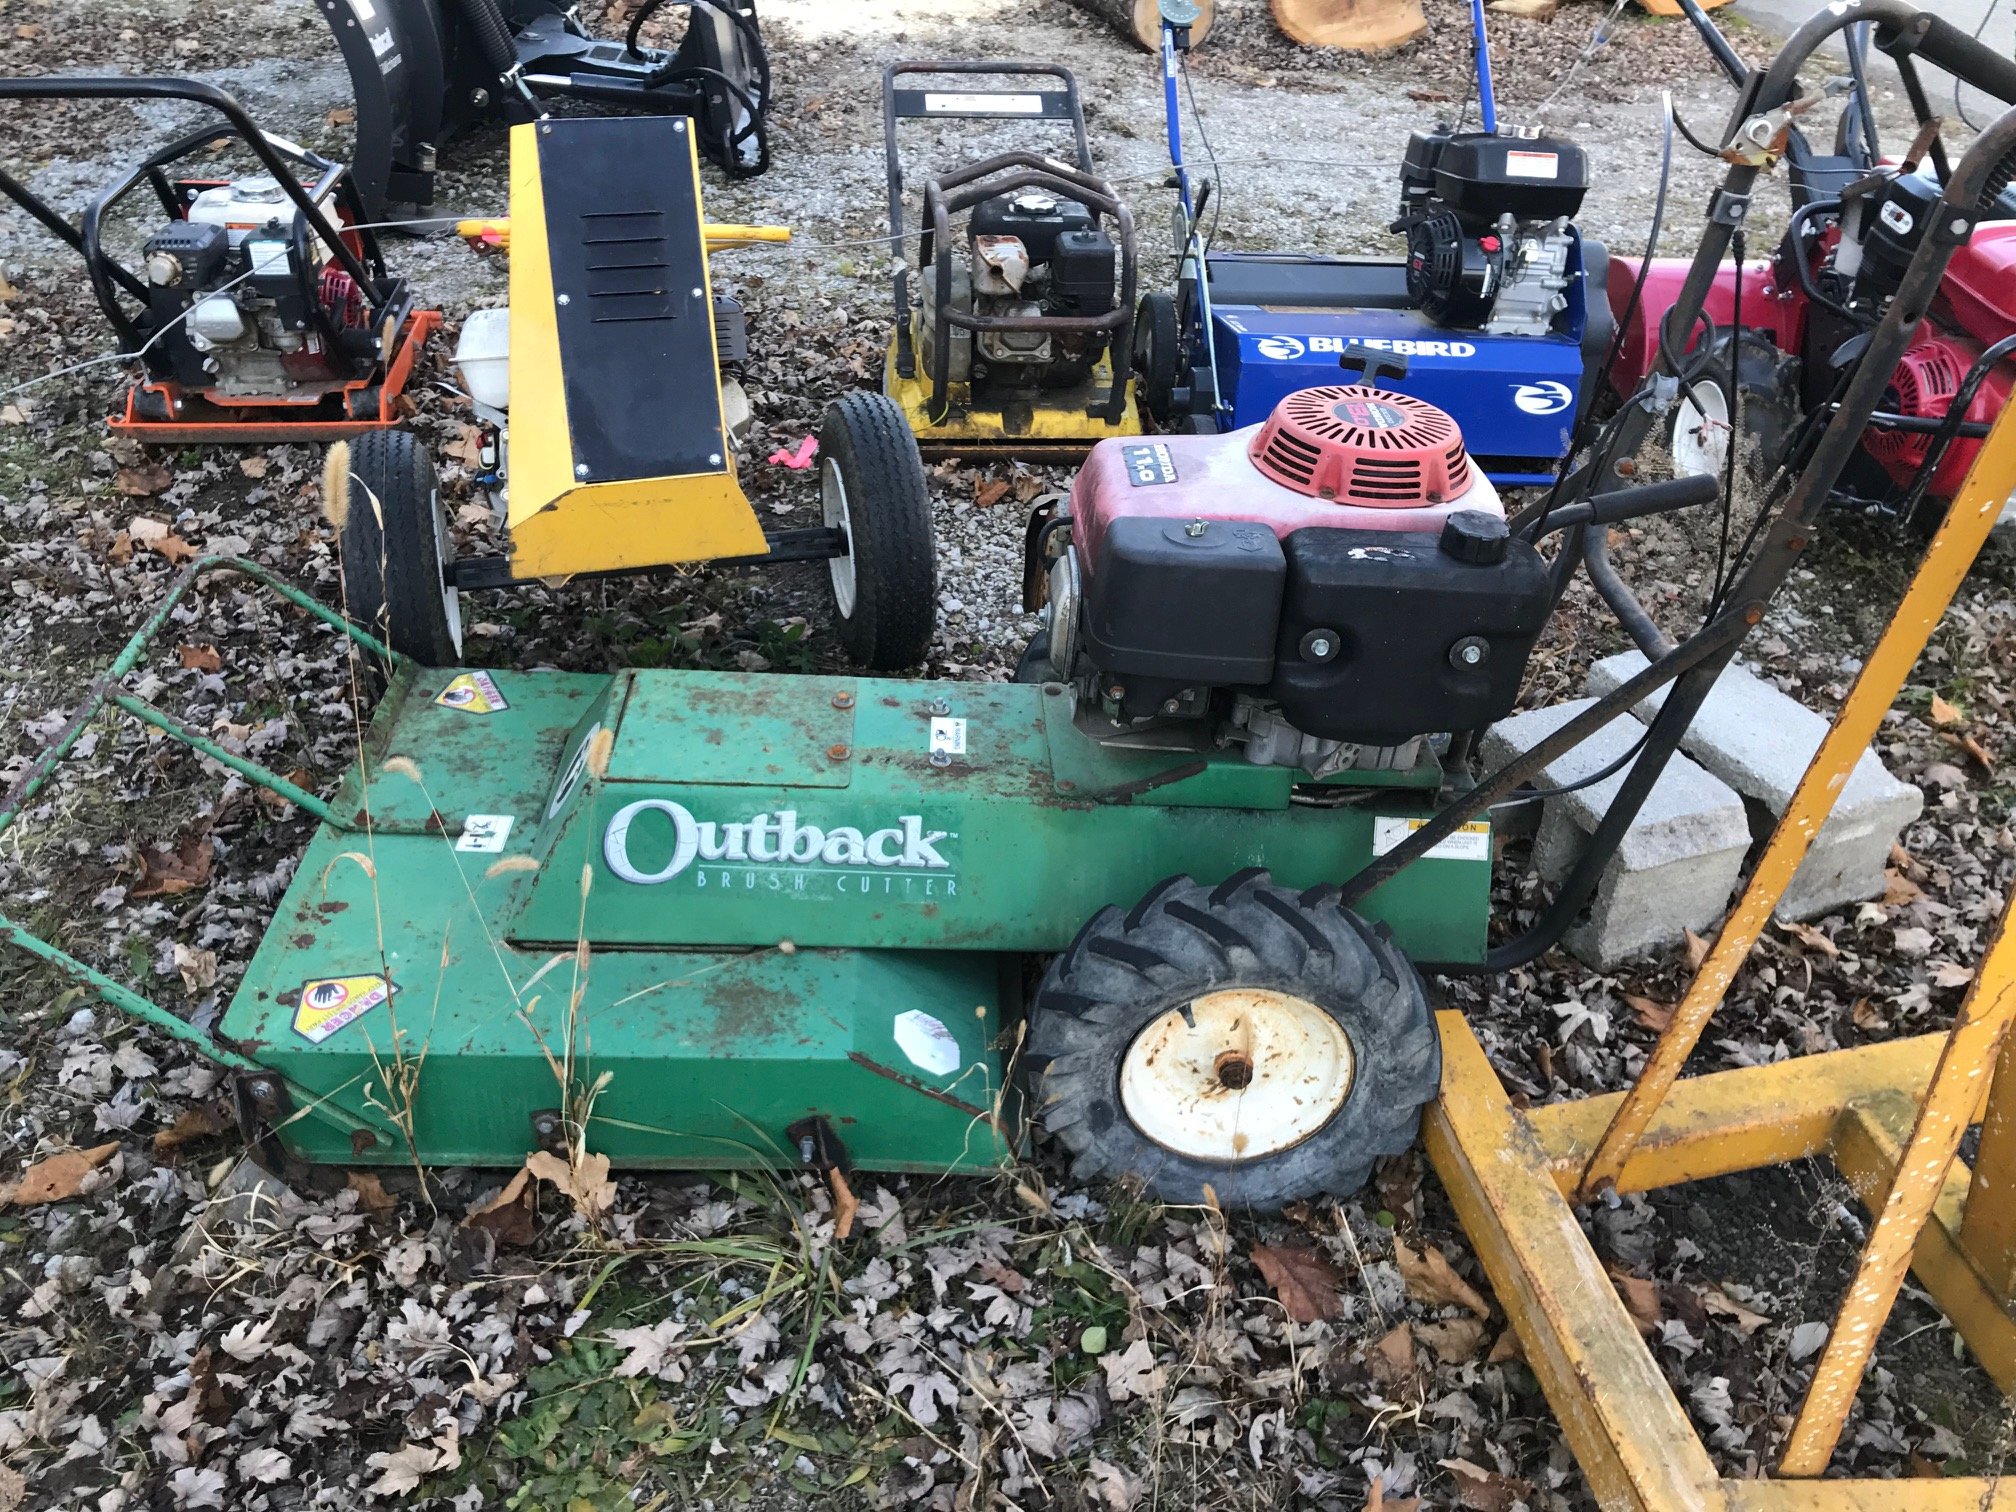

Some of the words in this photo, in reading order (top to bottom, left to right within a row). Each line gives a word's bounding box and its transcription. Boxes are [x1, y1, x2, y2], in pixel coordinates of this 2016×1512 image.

[1365, 402, 1389, 428] HONDA
[1133, 447, 1155, 481] 11.0
[1153, 443, 1176, 482] HONDA
[604, 799, 951, 885] Outback
[697, 871, 804, 890] BRUSH
[837, 876, 956, 896] CUTTER
